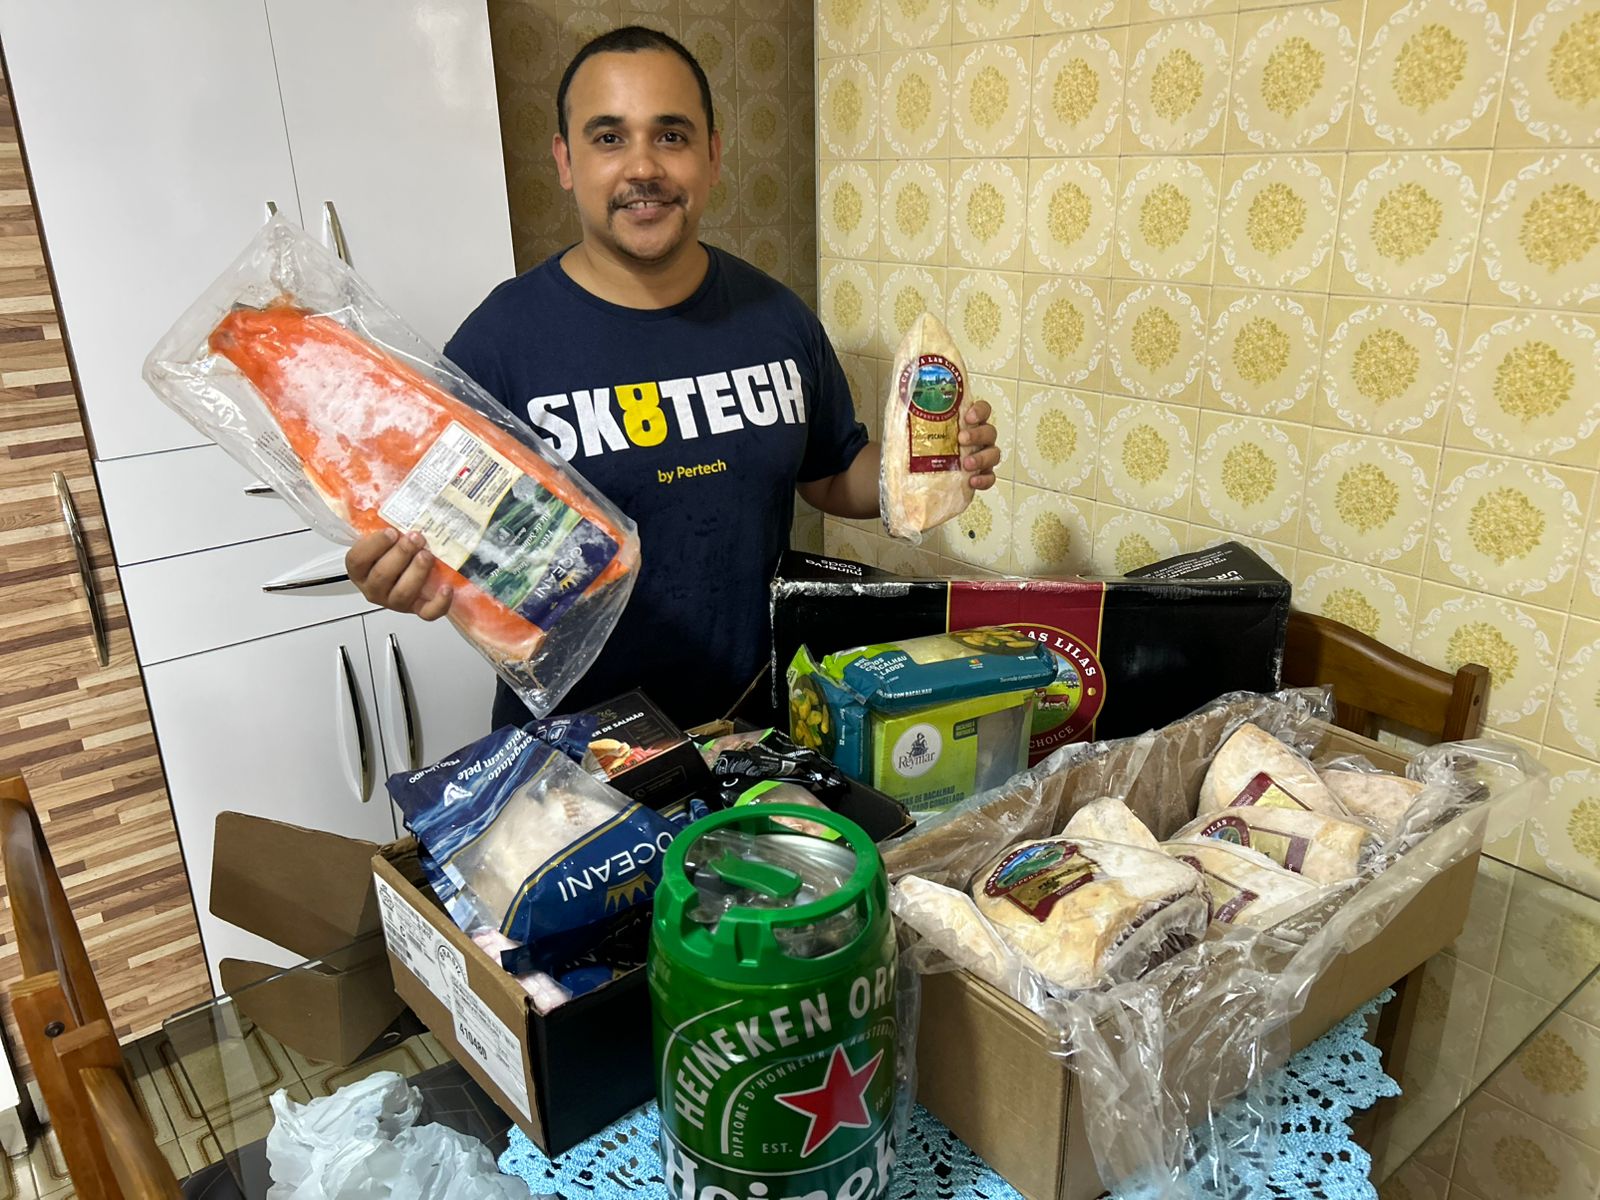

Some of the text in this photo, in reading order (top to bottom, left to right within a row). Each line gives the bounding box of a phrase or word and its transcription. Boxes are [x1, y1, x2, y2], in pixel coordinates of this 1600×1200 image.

[526, 358, 806, 462] SK8TECH
[657, 459, 727, 483] by Pertech
[805, 558, 863, 576] minerva
[820, 559, 863, 572] foods
[1054, 637, 1097, 678] LILAS
[603, 725, 614, 733] DE
[613, 711, 645, 728] SALMÃO
[1029, 725, 1075, 749] CHOICE
[457, 760, 483, 781] pele
[898, 752, 936, 769] Reymar
[558, 832, 675, 902] OCEANI
[675, 992, 832, 1130] HEINEKEN
[733, 1102, 749, 1159] DIPLOME
[747, 1050, 826, 1101] D'HONNEUR
[762, 1142, 793, 1154] EST.
